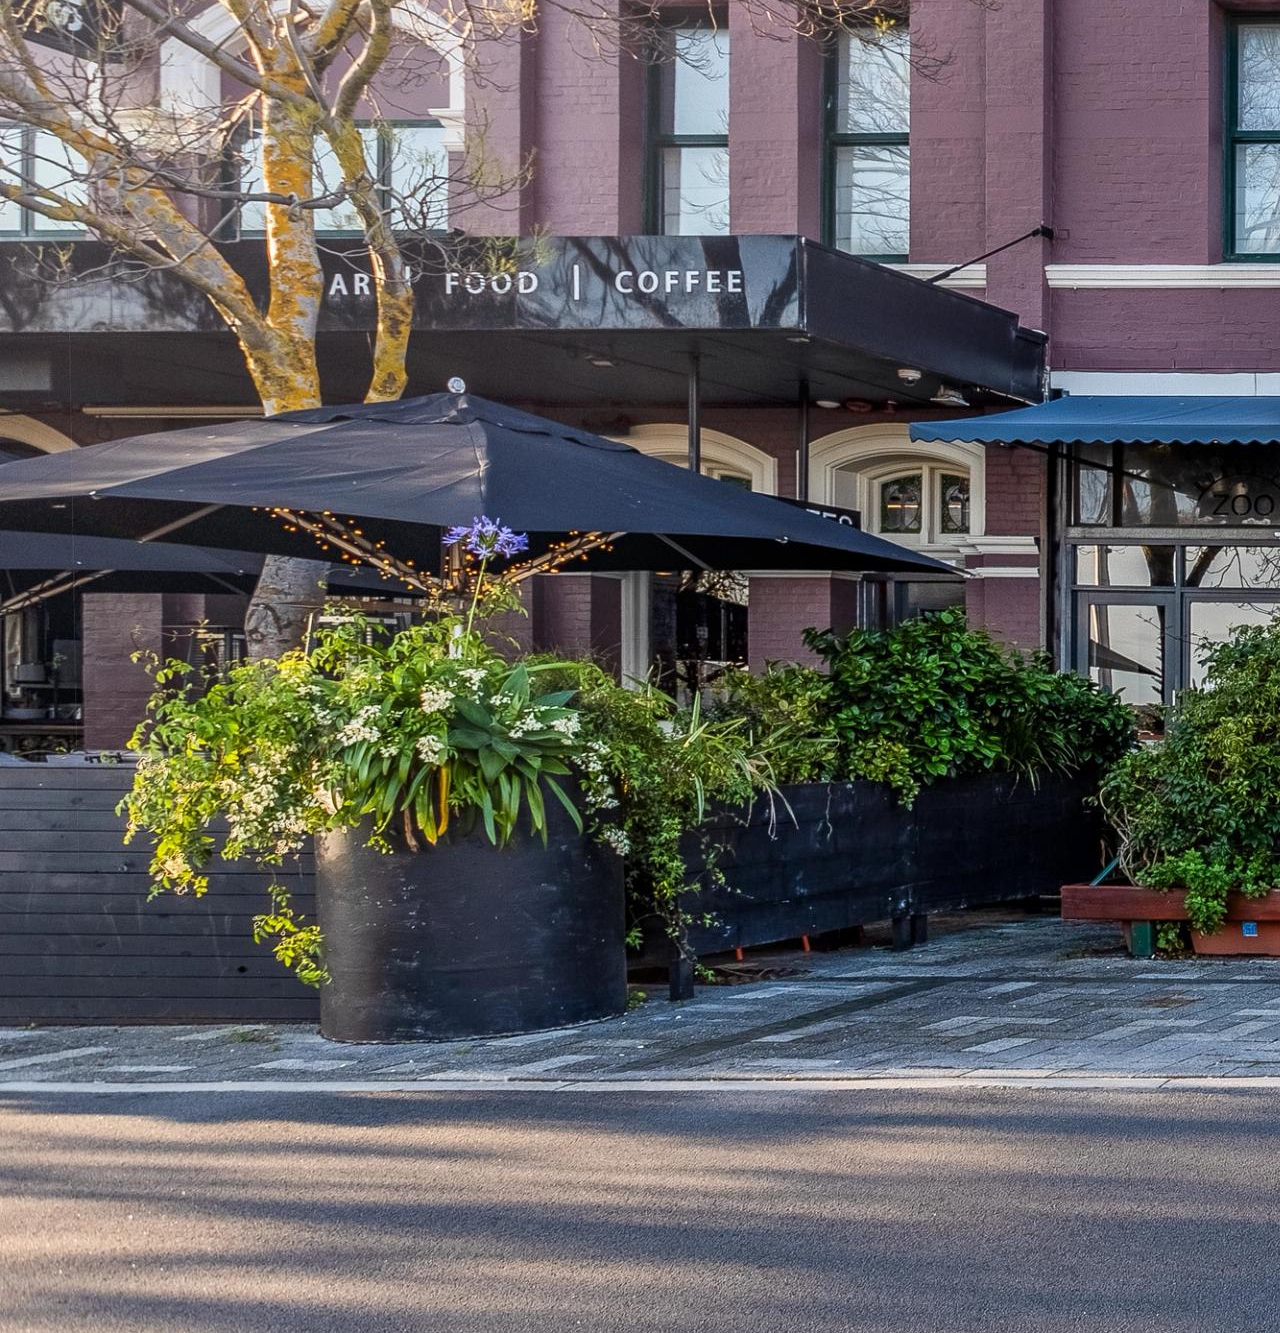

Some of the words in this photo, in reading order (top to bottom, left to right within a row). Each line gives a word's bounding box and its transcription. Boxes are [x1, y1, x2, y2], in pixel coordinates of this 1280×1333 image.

[328, 273, 371, 296] AR
[445, 270, 539, 295] FOOD
[615, 269, 744, 295] COFFEE
[1212, 494, 1275, 516] ZOO
